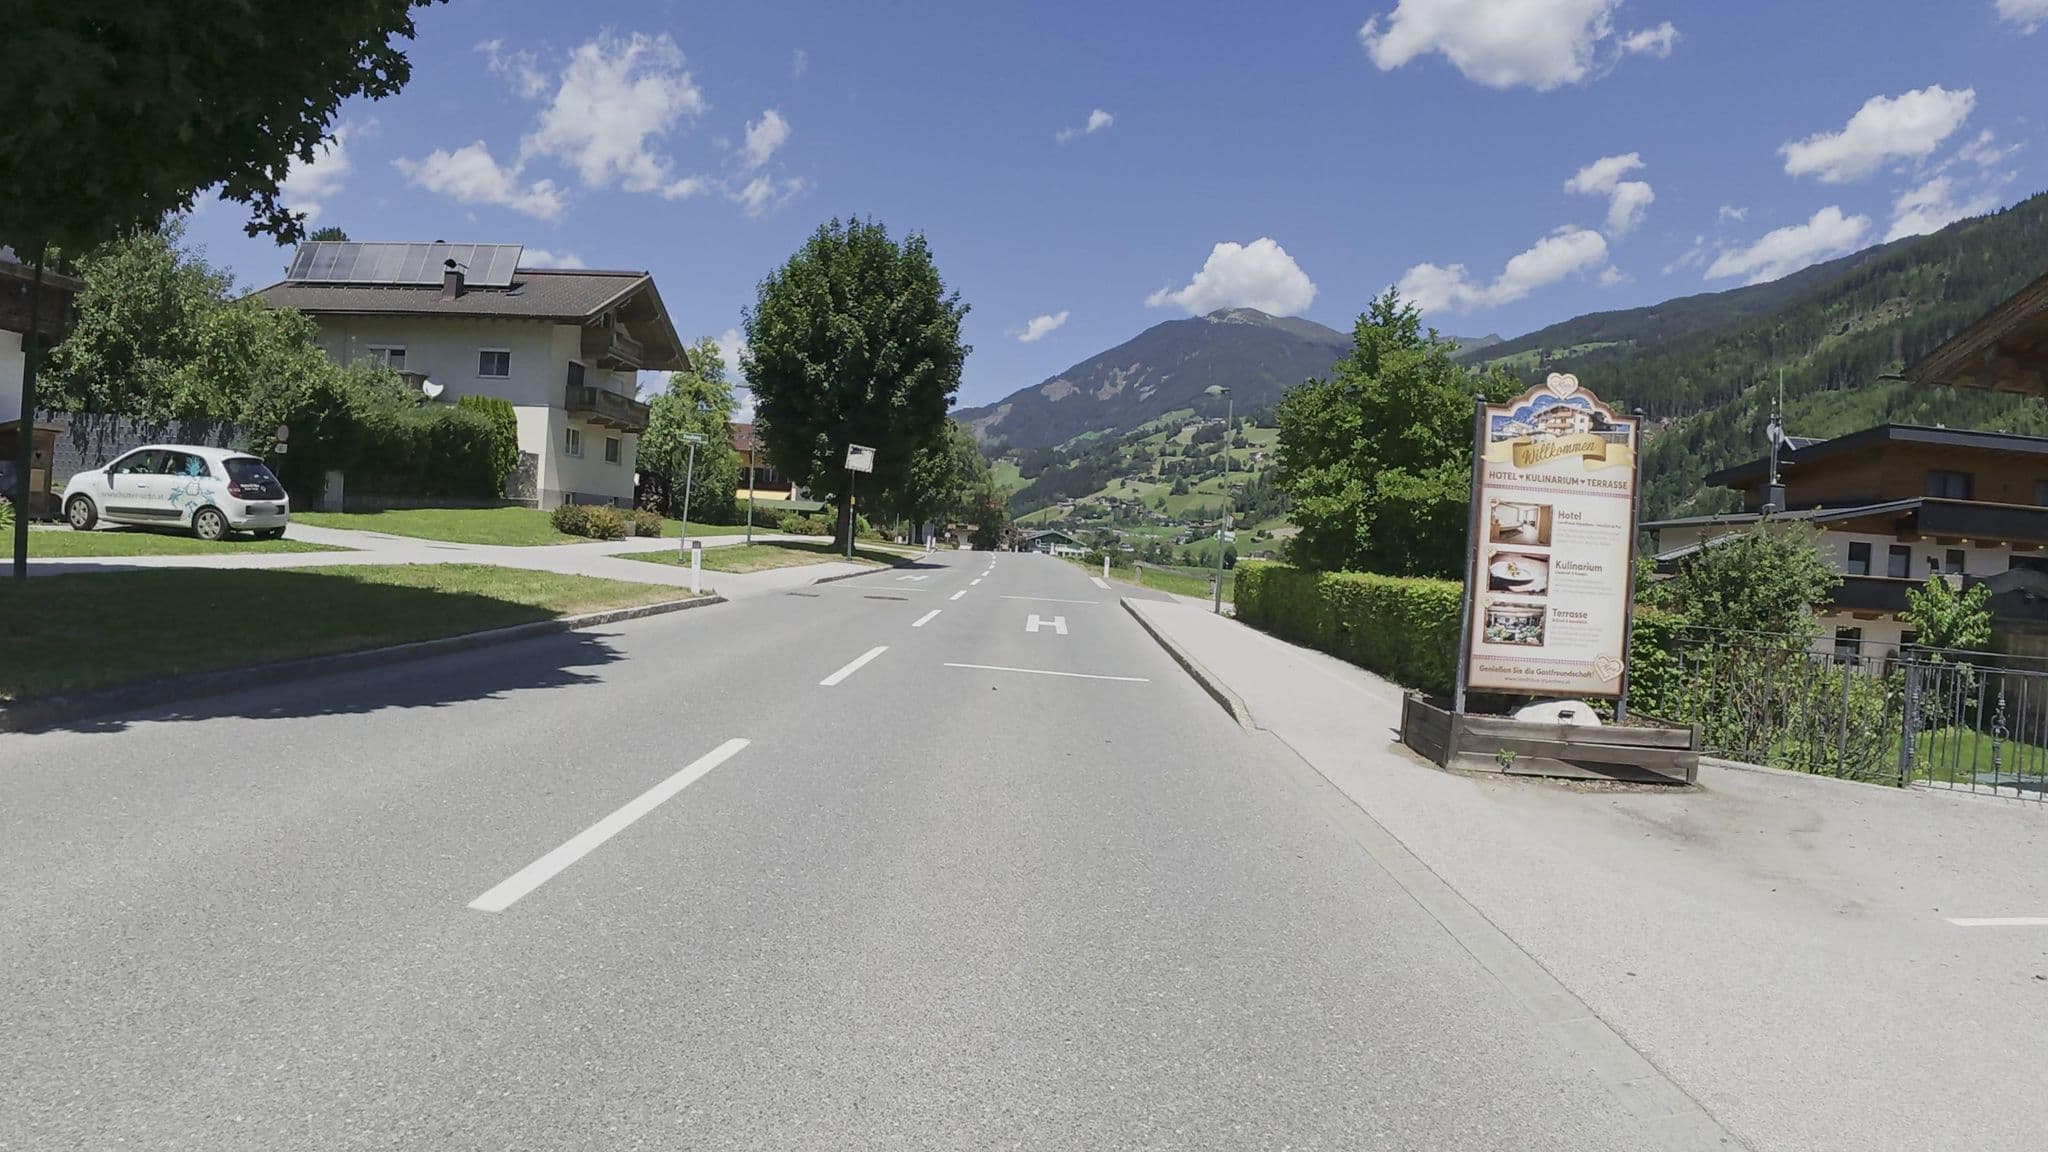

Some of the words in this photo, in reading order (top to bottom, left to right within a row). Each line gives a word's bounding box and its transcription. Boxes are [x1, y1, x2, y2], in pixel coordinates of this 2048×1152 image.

[1522, 440, 1597, 465] Willkommen
[1488, 471, 1518, 481] HOTEL
[1525, 473, 1580, 486] KULINARIUM
[1587, 478, 1628, 490] TERRASSE
[1558, 510, 1582, 520] Hotel
[1555, 560, 1603, 572] Kulinarium
[1552, 608, 1588, 619] Terrasse
[1025, 613, 1069, 635] H
[1512, 666, 1523, 675] Sie
